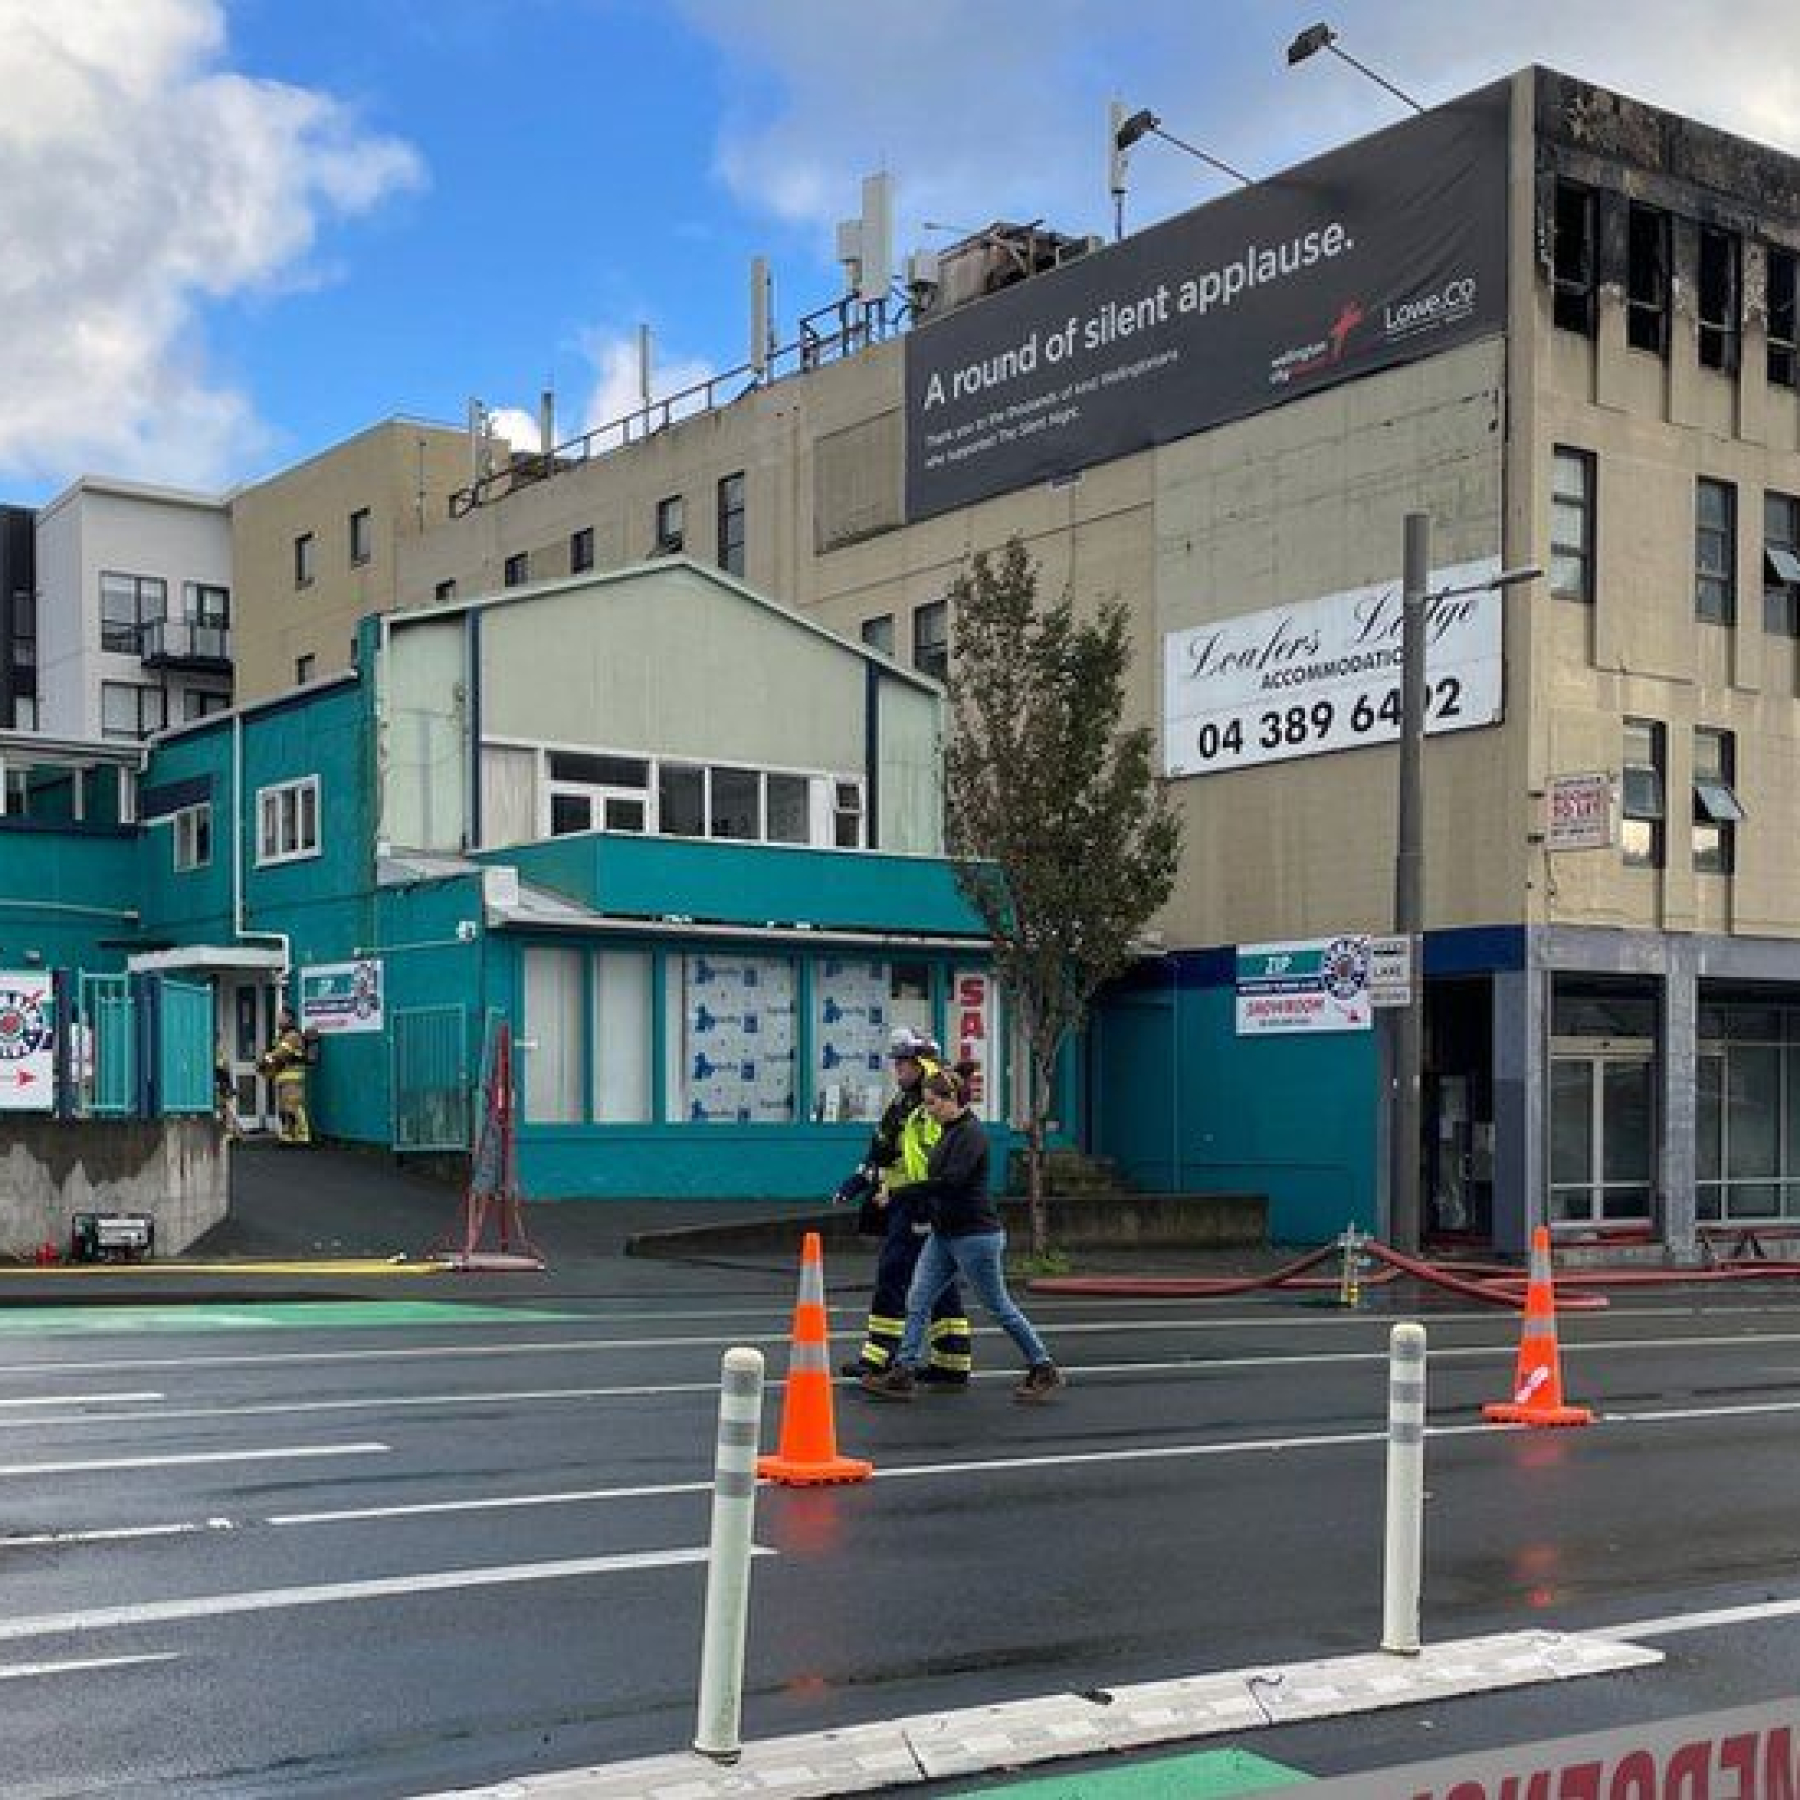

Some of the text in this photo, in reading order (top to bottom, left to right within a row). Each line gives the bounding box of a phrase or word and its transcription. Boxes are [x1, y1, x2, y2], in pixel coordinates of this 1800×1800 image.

[924, 219, 1355, 411] A round of silent applause.
[1190, 615, 1321, 679] Loafers
[1262, 645, 1402, 690] ACCOMMODATIO
[1200, 677, 1461, 759] 04 389 642
